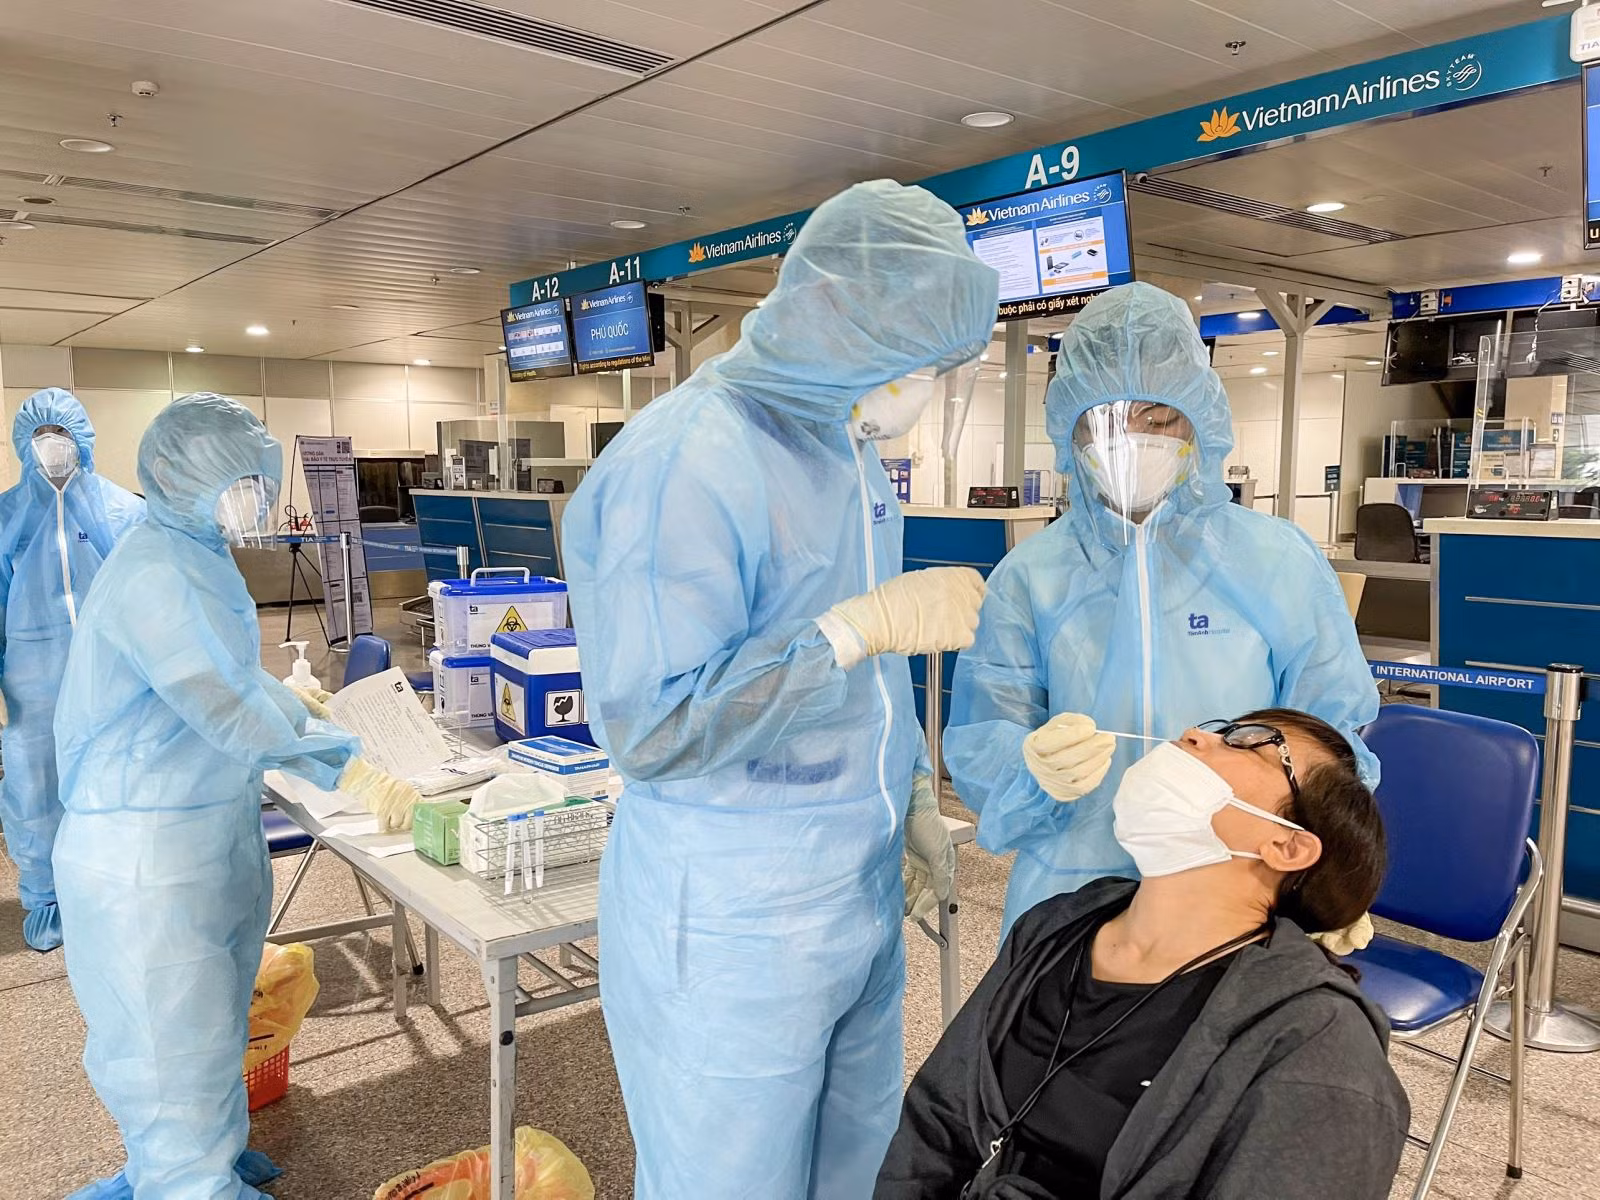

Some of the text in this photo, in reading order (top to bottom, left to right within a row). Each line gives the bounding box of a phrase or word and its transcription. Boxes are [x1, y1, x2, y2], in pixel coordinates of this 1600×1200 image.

[1240, 68, 1440, 132] Vietnam Airlines
[1024, 145, 1080, 189] A-9
[988, 201, 1040, 221] Vietnam
[1041, 191, 1090, 212] Airlines
[705, 240, 744, 259] Vietnam
[744, 230, 782, 250] Airlines
[609, 256, 640, 285] A-11
[532, 277, 560, 302] A-12
[1018, 301, 1035, 314] phải
[1036, 300, 1047, 310] có
[1048, 297, 1065, 311] giấy
[1066, 295, 1080, 306] xét
[607, 320, 629, 339] QUỐC
[873, 502, 886, 518] ta
[78, 531, 88, 540] ta
[1188, 613, 1209, 630] ta
[1376, 665, 1473, 684] INTERNATIONAL
[1475, 674, 1535, 690] AIRPORT
